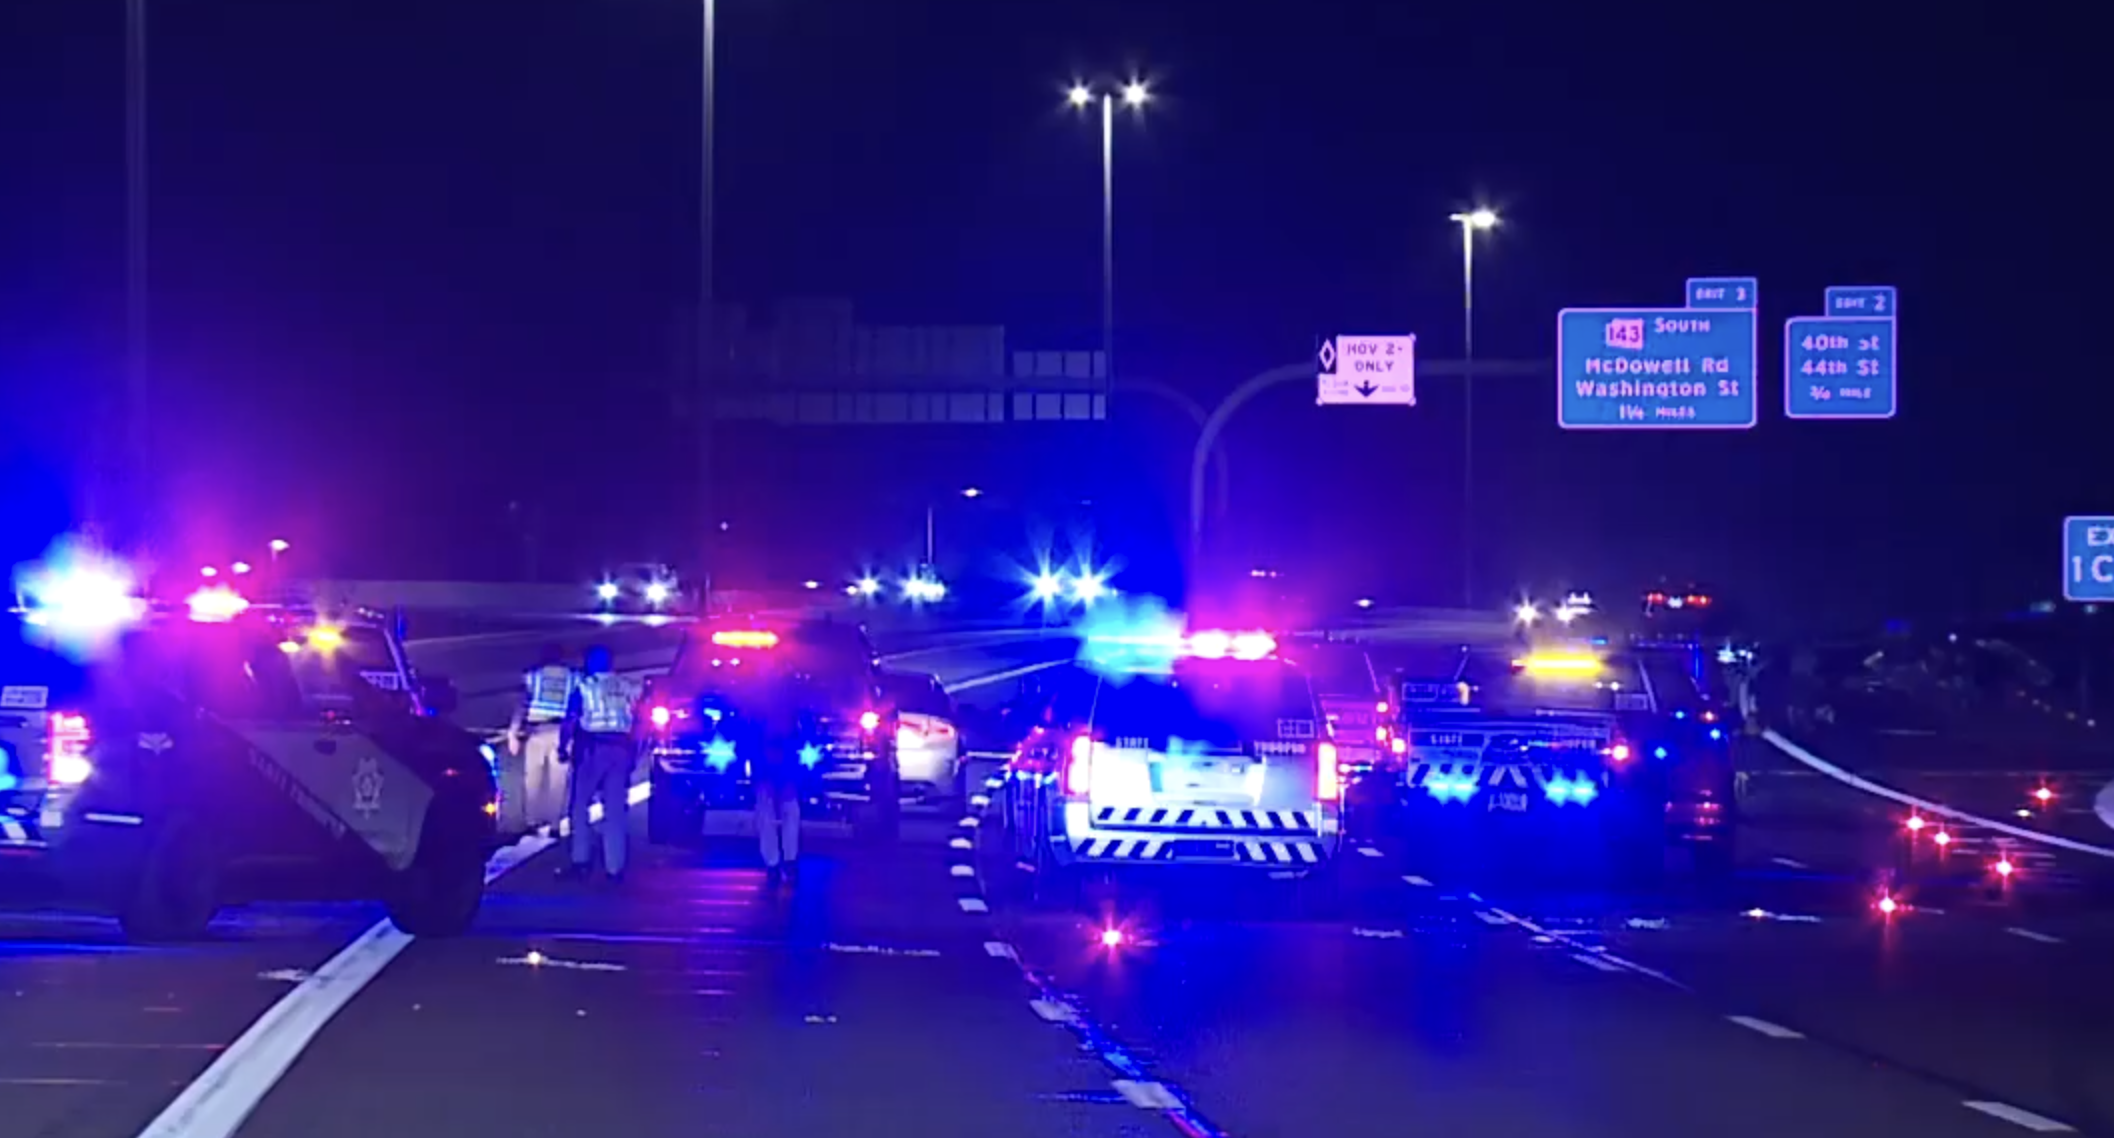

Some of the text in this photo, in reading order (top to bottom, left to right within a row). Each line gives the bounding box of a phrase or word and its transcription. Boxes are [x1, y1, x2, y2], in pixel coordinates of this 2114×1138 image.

[1873, 294, 1886, 312] 2
[1609, 325, 1640, 343] 143
[1801, 334, 1848, 350] 40th
[1347, 344, 1377, 355] HOV
[1355, 361, 1394, 373] ONLY
[1585, 357, 1729, 374] McDowell Rd
[1801, 359, 1880, 375] 44th St
[1576, 379, 1739, 399] Washington St
